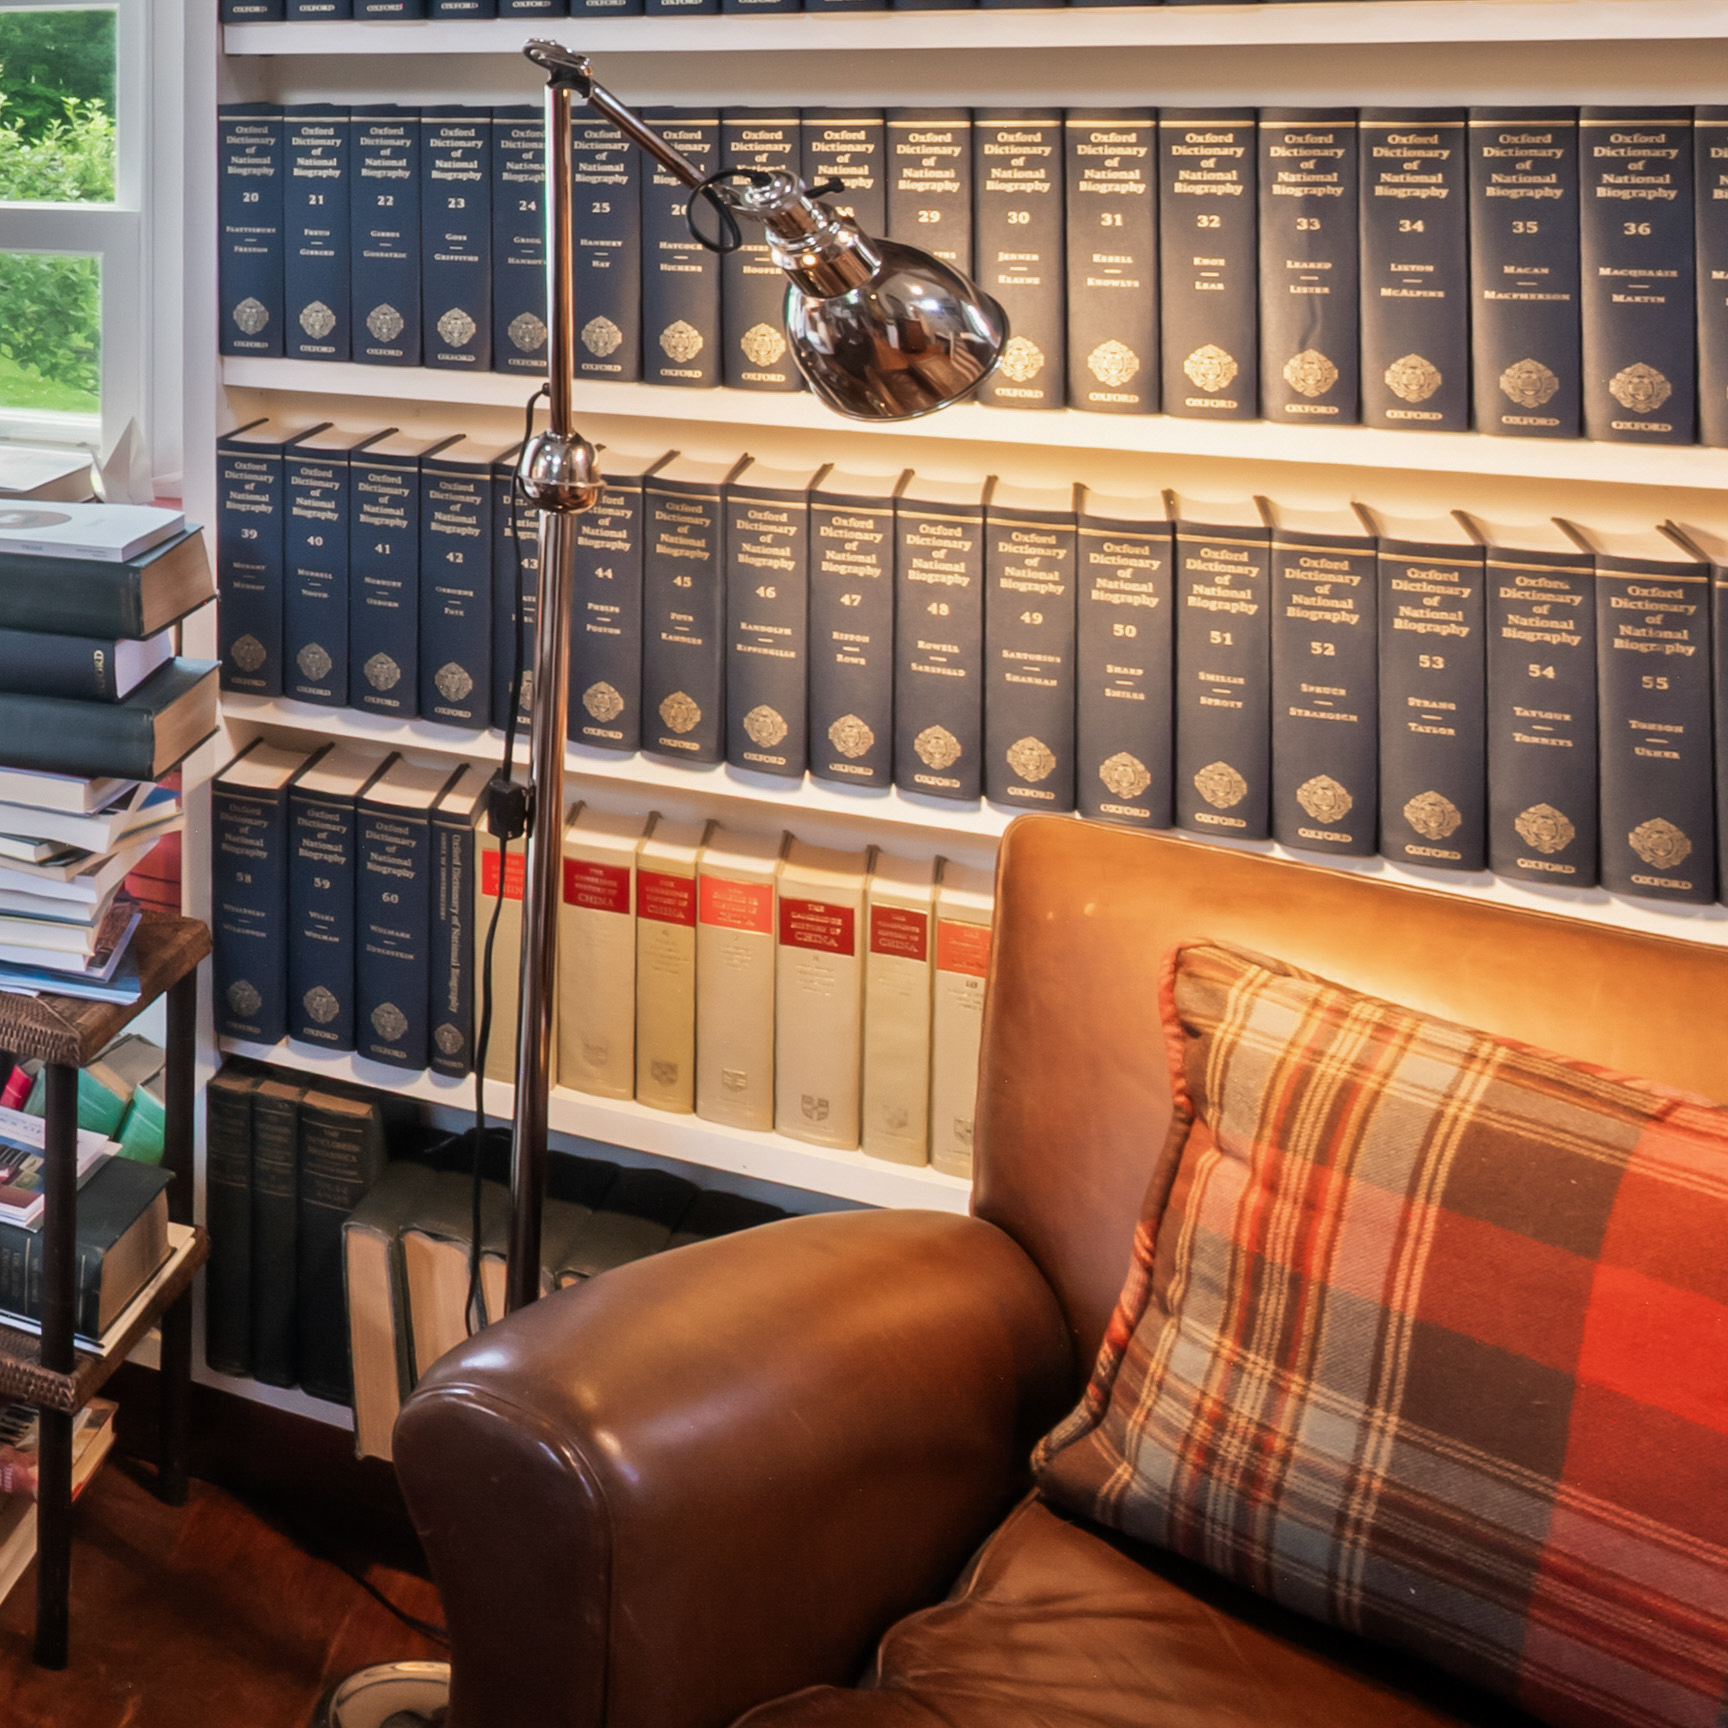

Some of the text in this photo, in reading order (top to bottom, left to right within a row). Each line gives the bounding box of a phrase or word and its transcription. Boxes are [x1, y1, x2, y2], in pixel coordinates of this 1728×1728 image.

[1090, 132, 1137, 144] Oxford
[1077, 144, 1147, 158] Dictionary
[1104, 156, 1120, 168] of
[1084, 168, 1140, 181] National
[1079, 181, 1146, 195] Biography
[1100, 213, 1123, 228] 31
[1011, 531, 1056, 546] Oxford
[998, 542, 1067, 559] Dictionary
[1025, 556, 1040, 568] of
[1004, 566, 1060, 582] National
[1407, 568, 1459, 583] Oxford
[999, 578, 1065, 596] Biography
[1392, 580, 1471, 597] Dictionary
[1423, 595, 1440, 606] of
[1020, 612, 1043, 625] 49
[1399, 606, 1464, 622] National
[1393, 618, 1470, 637] Biography
[1419, 655, 1444, 669] 53
